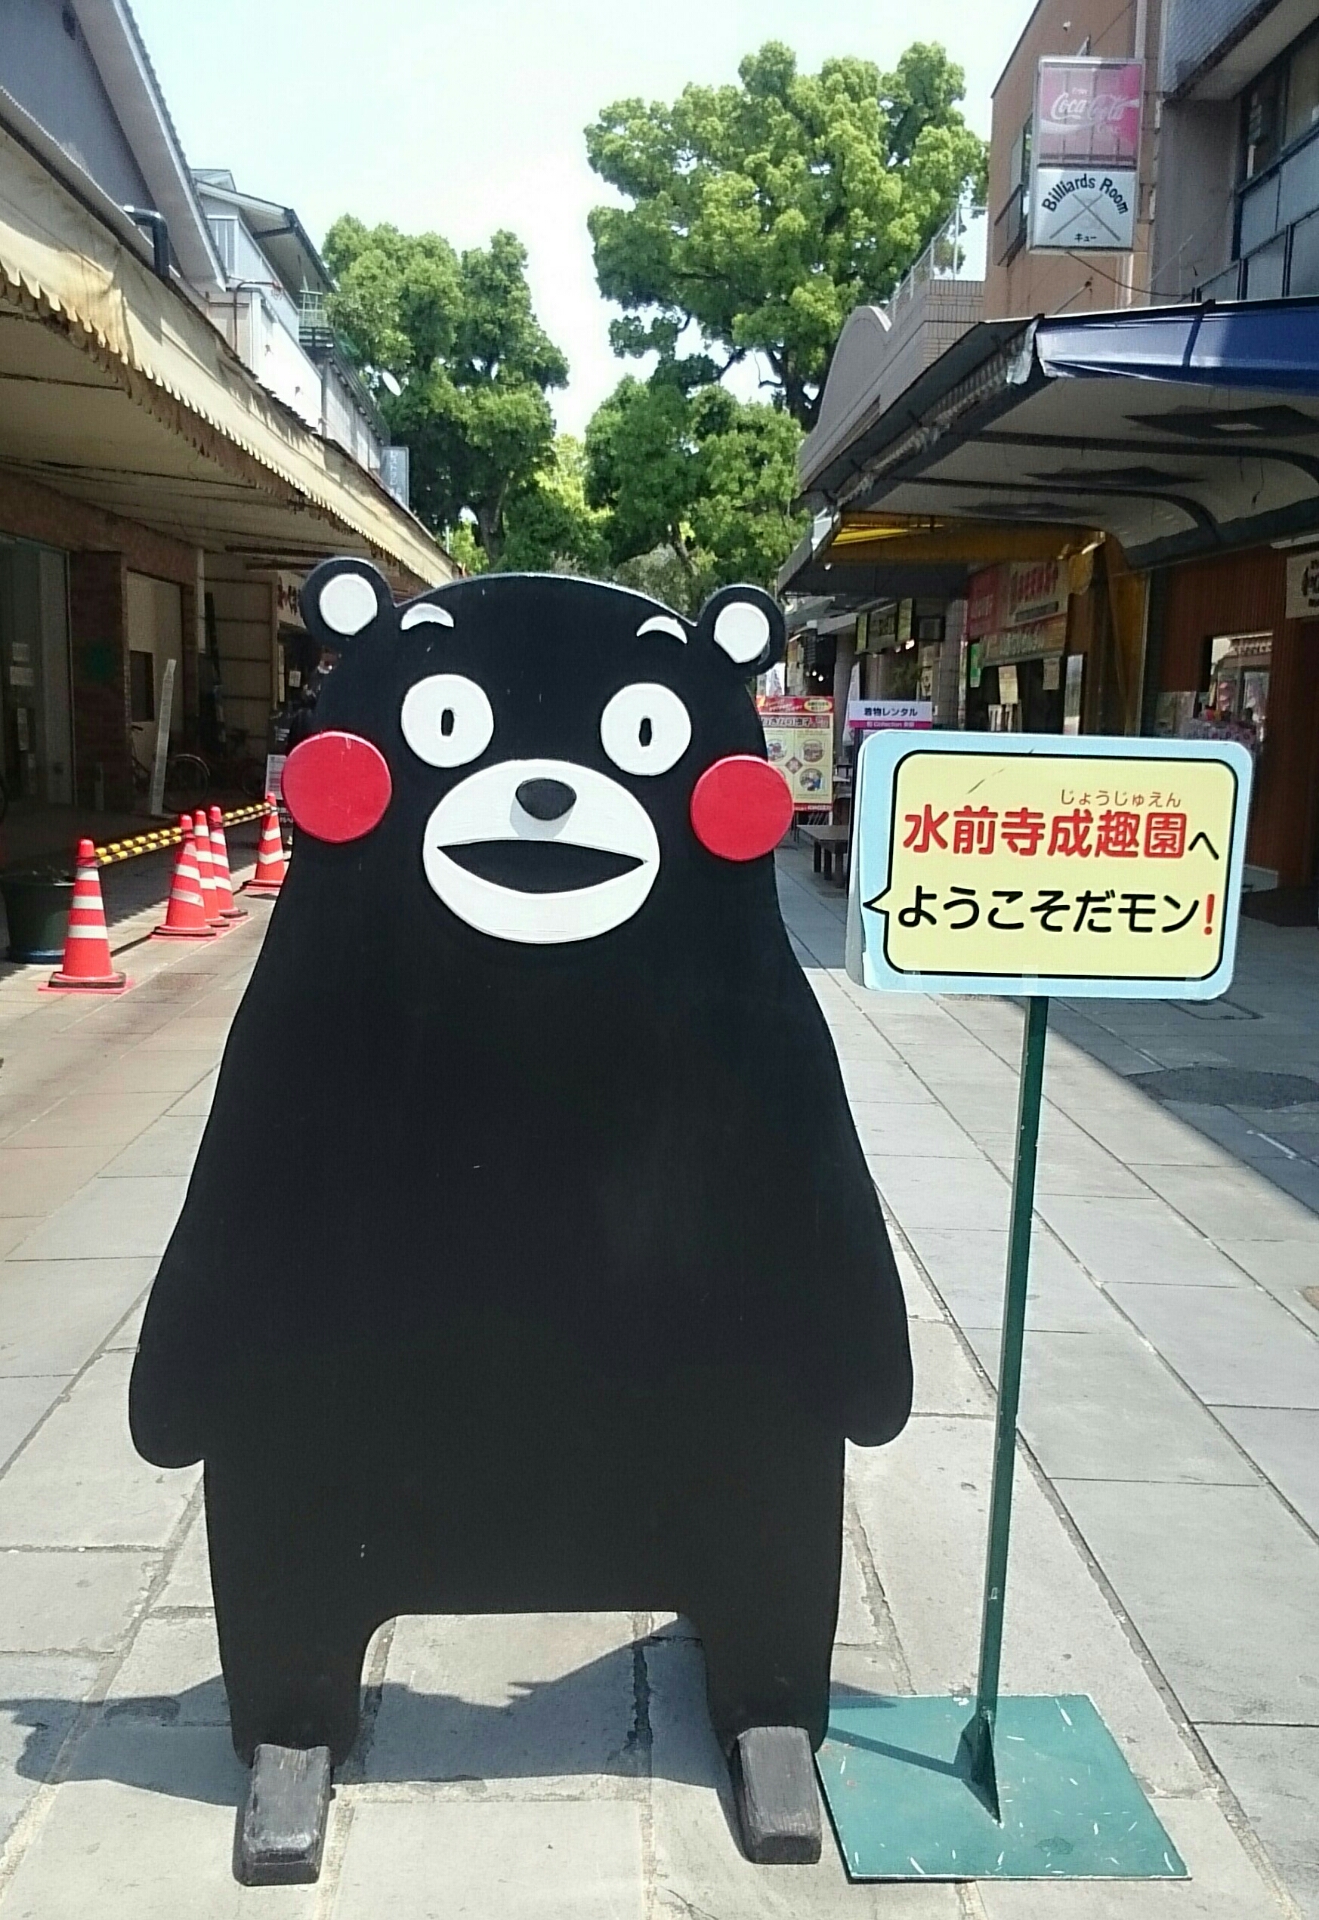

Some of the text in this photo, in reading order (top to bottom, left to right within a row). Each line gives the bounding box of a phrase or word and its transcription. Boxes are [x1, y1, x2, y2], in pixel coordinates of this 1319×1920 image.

[1041, 173, 1129, 215] Billiards Room
[1074, 233, 1097, 242] キュー
[863, 706, 918, 717] 着物レンタル
[1060, 788, 1182, 808] じょうじゅえん
[903, 804, 1220, 861] 水前寺成趣園へ
